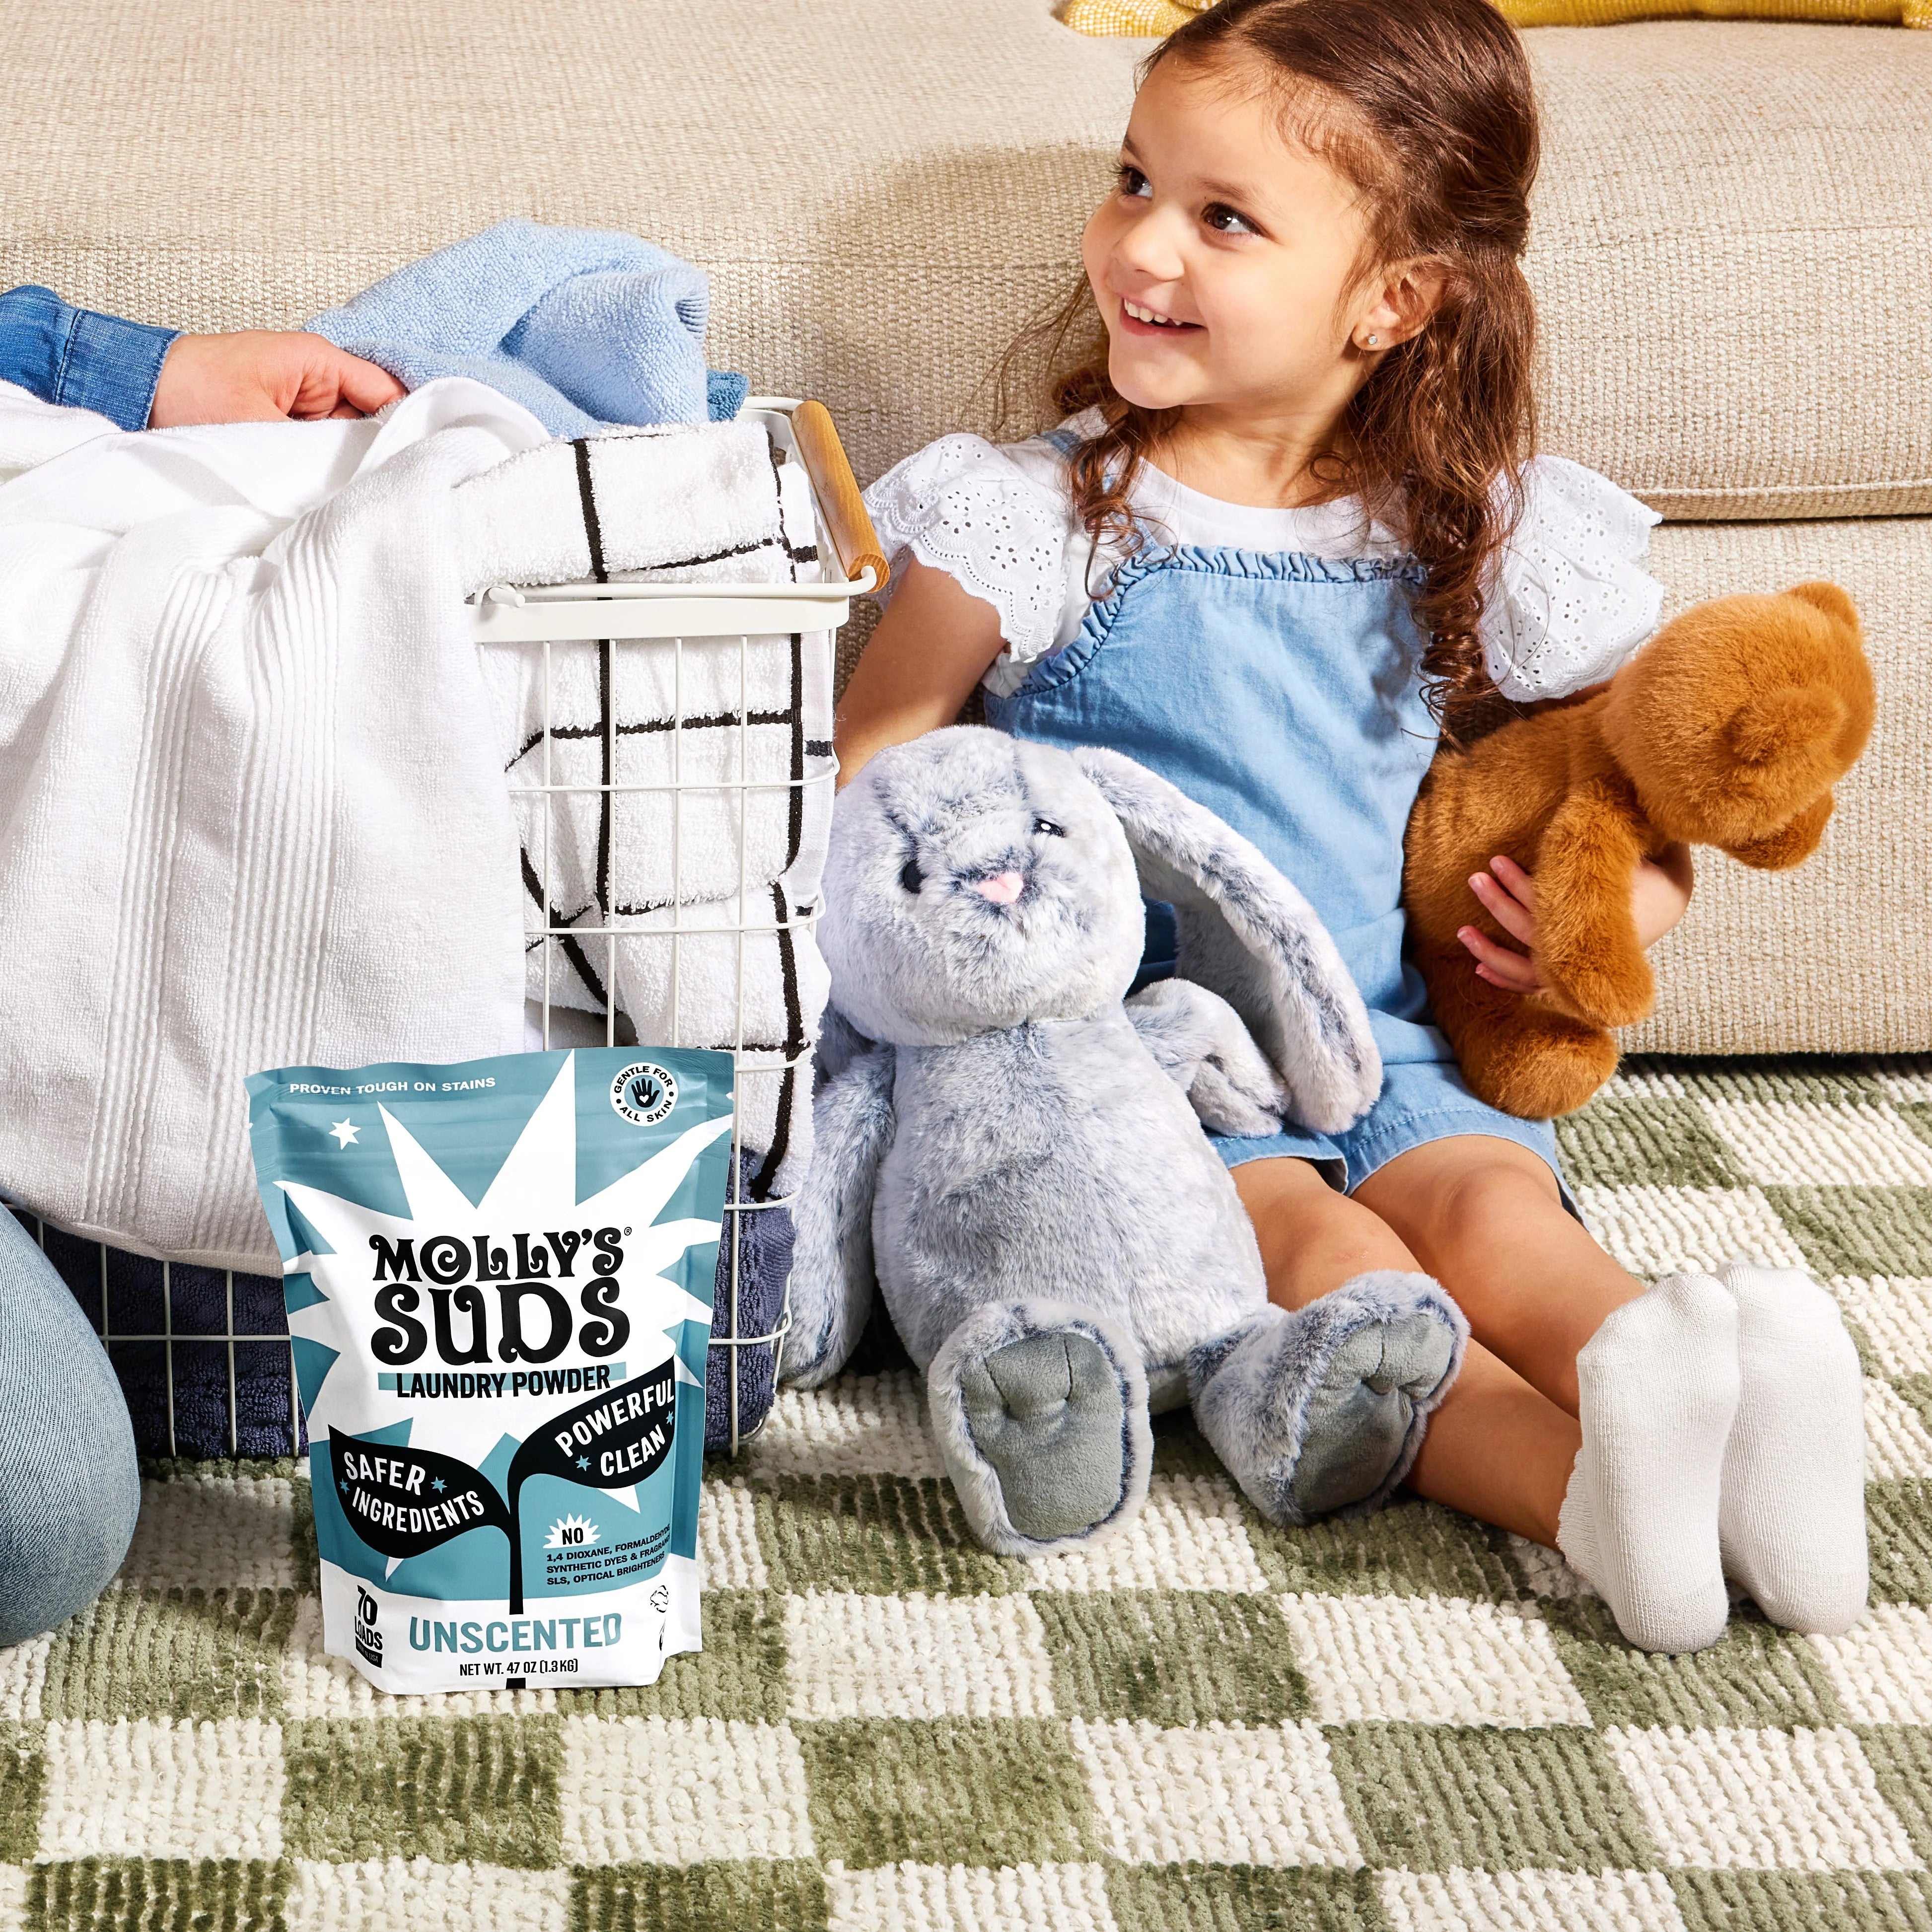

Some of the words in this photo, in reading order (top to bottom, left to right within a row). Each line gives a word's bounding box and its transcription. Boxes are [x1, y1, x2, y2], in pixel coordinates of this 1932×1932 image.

[290, 1083, 351, 1094] PROVEN
[357, 1082, 408, 1094] TOUGH
[414, 1082, 435, 1091] ON
[441, 1077, 496, 1091] STAINS
[614, 1066, 649, 1093] GENTLE
[653, 1068, 673, 1087] FOR
[620, 1107, 640, 1122] ALL
[646, 1100, 672, 1122] SKIN
[370, 1277, 630, 1365] SUDS
[397, 1372, 507, 1398] LAUNDRY
[512, 1364, 610, 1397] POWDER
[555, 1378, 674, 1457] POWERFUL
[600, 1424, 665, 1476] CLEAN
[344, 1452, 426, 1496] SAFER
[352, 1487, 485, 1533] INGREDIENTS
[562, 1527, 583, 1545] NO
[547, 1553, 563, 1562] 1,4
[567, 1547, 612, 1560] DIOXANE,
[547, 1561, 602, 1574] SYNTHETIC
[604, 1555, 627, 1567] DYES
[573, 1571, 615, 1583] OPTICAL
[617, 1551, 664, 1576] BRIGHTENERS
[357, 1585, 378, 1626] 70
[355, 1616, 383, 1650] LOADS
[409, 1613, 622, 1653] UNSCENTED
[369, 1653, 378, 1662] USA
[460, 1664, 481, 1676] NET
[484, 1663, 504, 1675] WT.
[506, 1662, 520, 1674] 47
[523, 1661, 537, 1673] OZ
